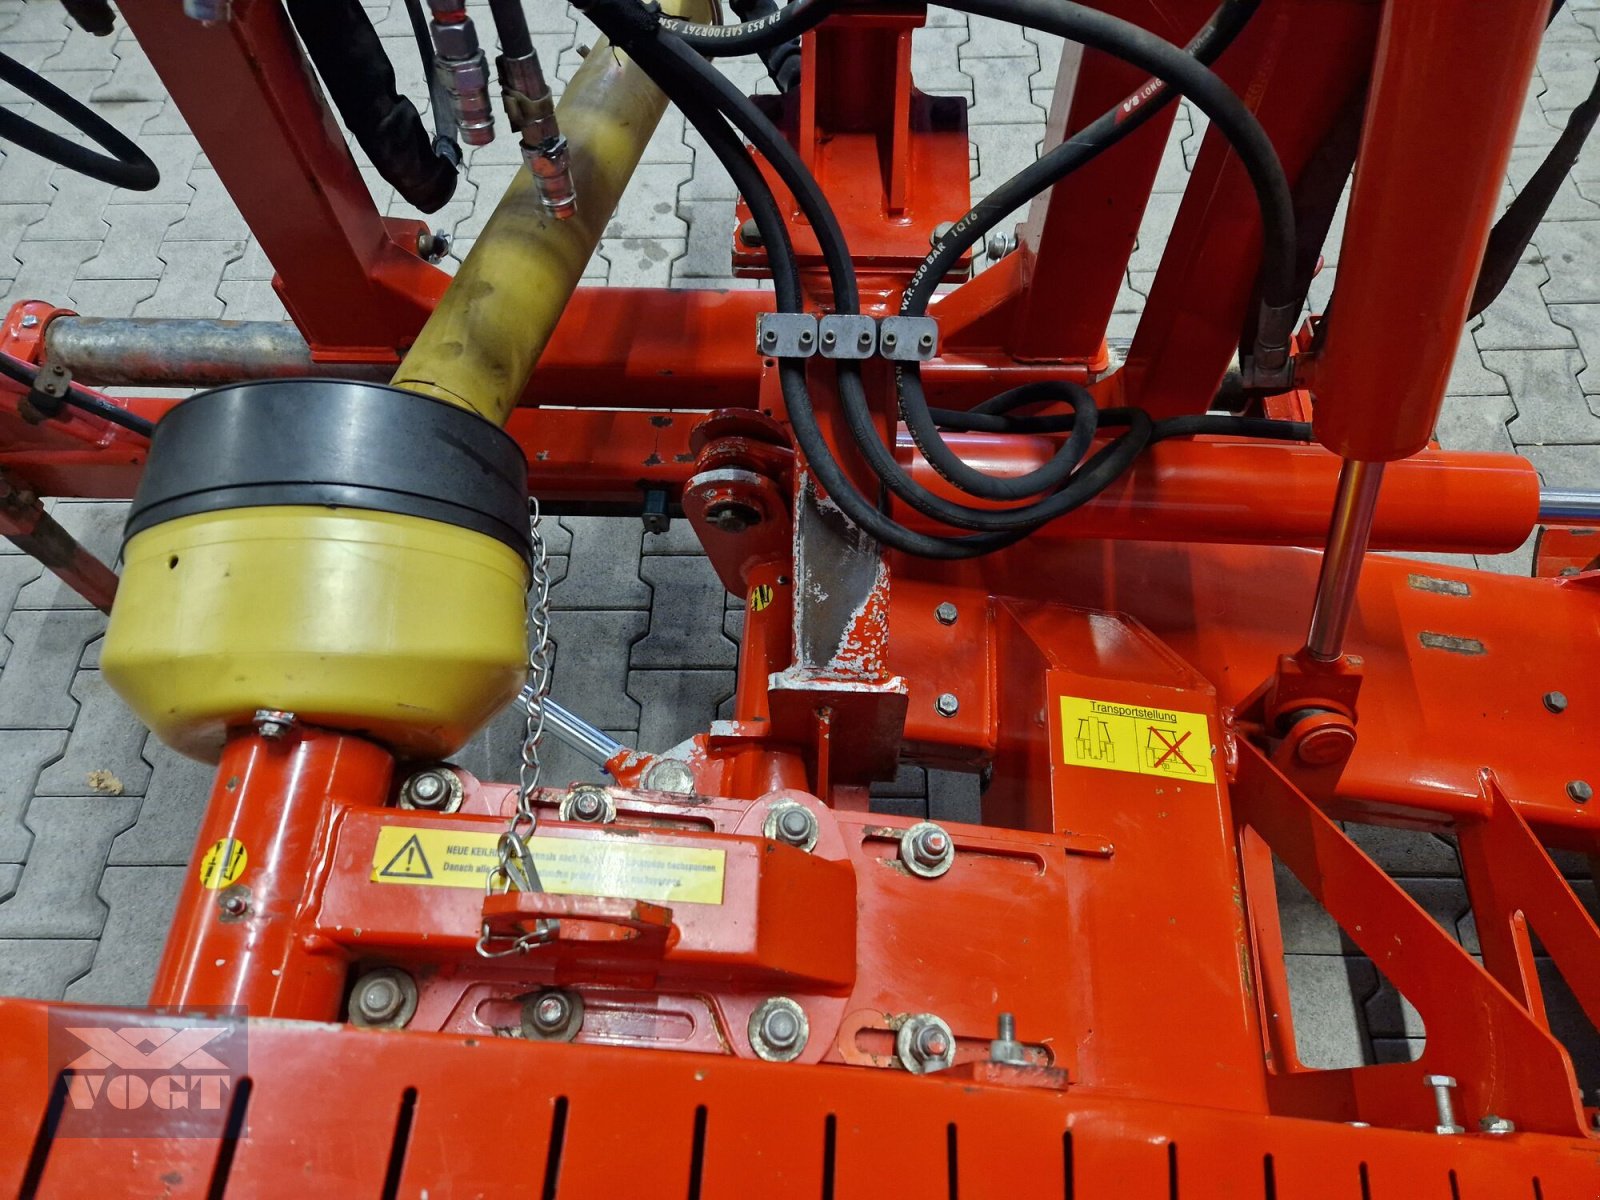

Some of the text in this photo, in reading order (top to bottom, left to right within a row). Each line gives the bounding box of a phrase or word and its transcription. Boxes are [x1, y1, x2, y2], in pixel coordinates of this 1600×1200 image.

[768, 11, 781, 26] EN
[681, 25, 743, 38] SAE100R2AT
[747, 19, 765, 33] 853
[900, 287, 915, 311] W.P.
[912, 264, 928, 287] 330
[926, 242, 946, 265] BAR
[1089, 701, 1177, 724] Transportstellung
[446, 845, 469, 856] NEUE
[443, 861, 474, 873] Danach
